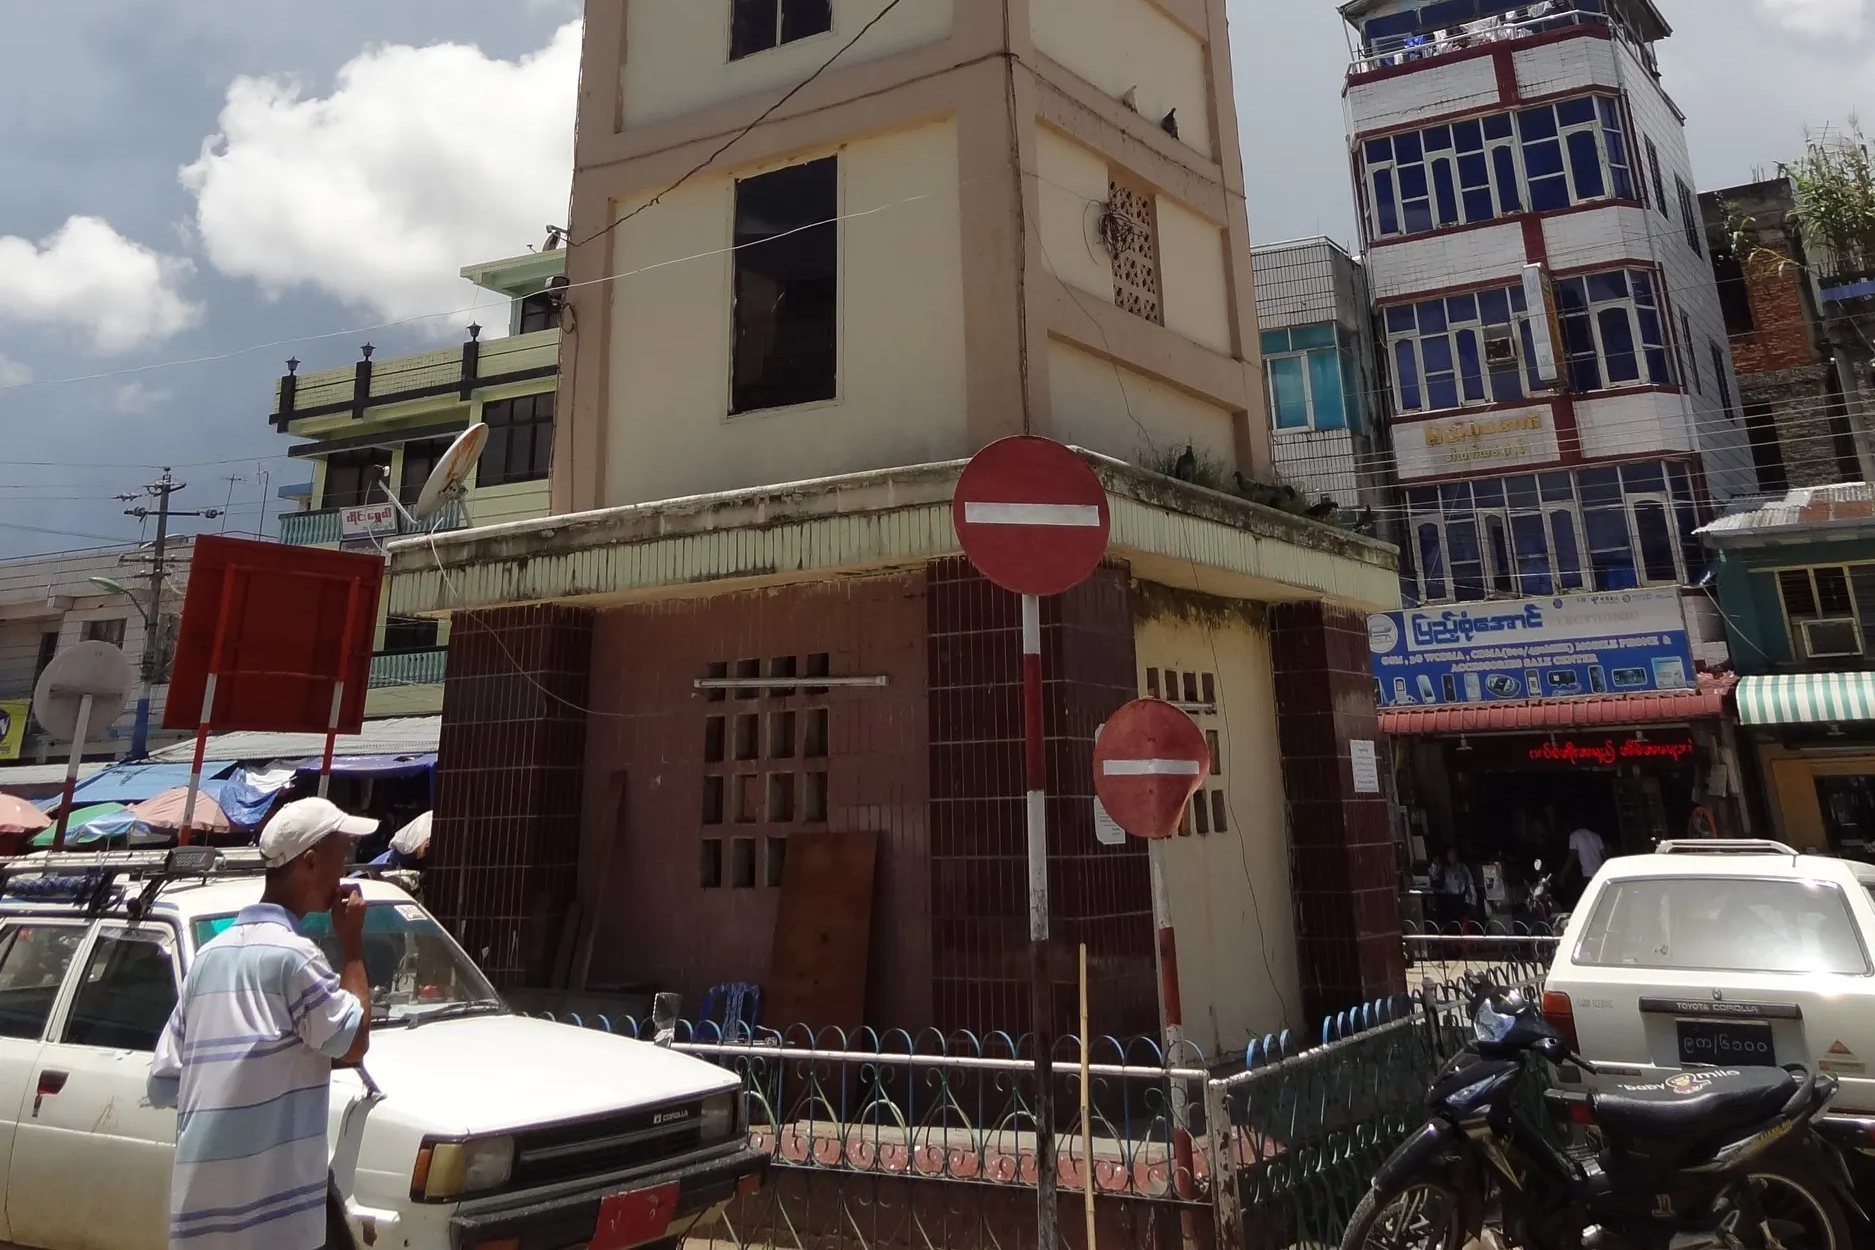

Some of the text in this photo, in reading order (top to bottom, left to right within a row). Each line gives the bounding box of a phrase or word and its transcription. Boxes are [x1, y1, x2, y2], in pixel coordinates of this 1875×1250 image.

[1575, 639, 1618, 651] MOBILE
[1619, 636, 1659, 648] PHONE
[1523, 656, 1552, 669] SALE
[1553, 654, 1598, 666] CENTER
[1676, 1002, 1759, 1013] TOYOTA COROLLA
[662, 1110, 689, 1122] COROLLA
